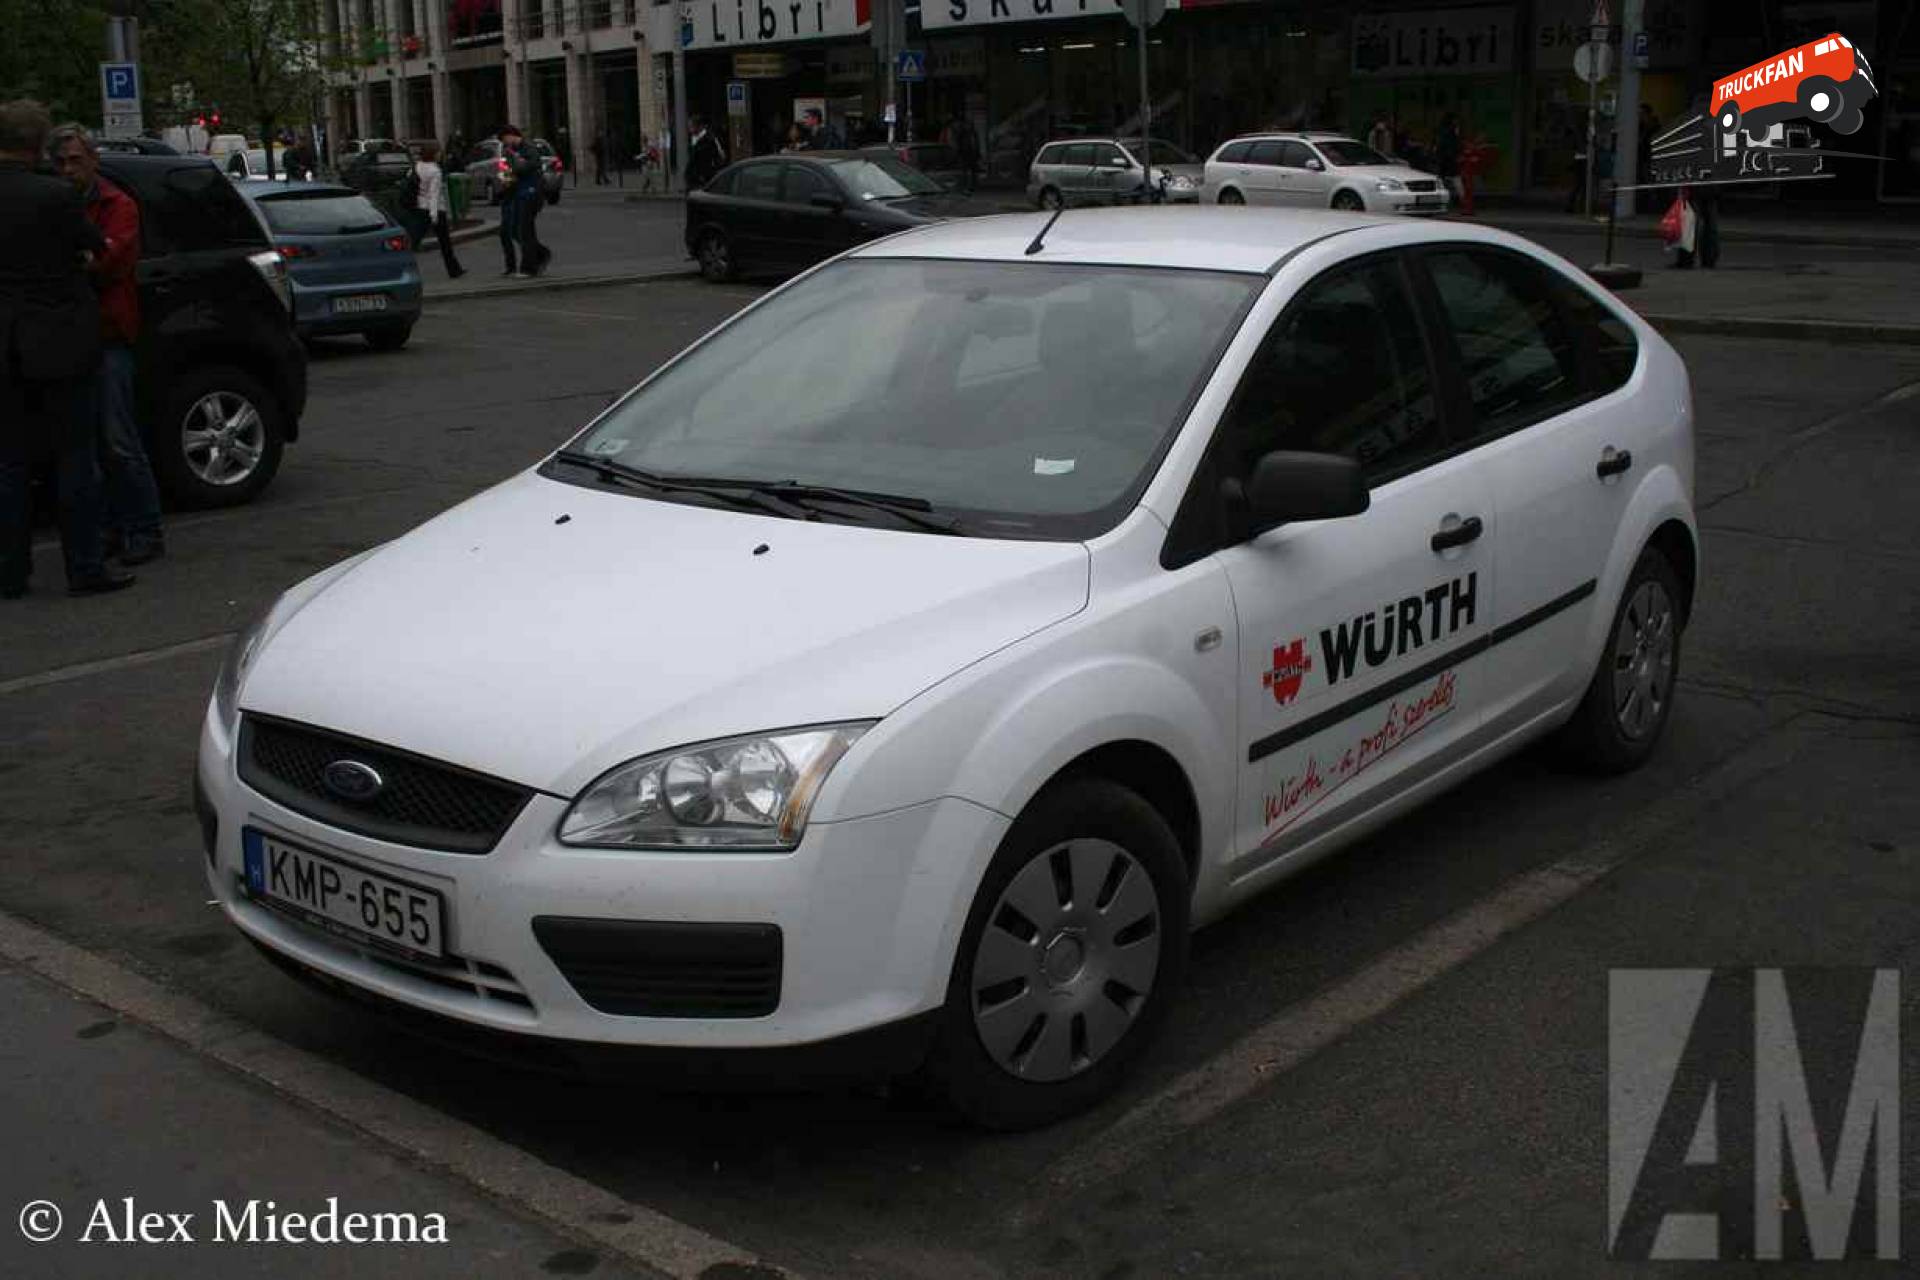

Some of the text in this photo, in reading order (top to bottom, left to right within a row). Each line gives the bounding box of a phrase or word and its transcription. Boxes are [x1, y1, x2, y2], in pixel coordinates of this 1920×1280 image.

[712, 0, 824, 41] Libri
[1397, 25, 1497, 65] Libri
[111, 71, 128, 97] P
[1320, 572, 1476, 685] WÜRTH
[269, 846, 430, 945] KMP-655
